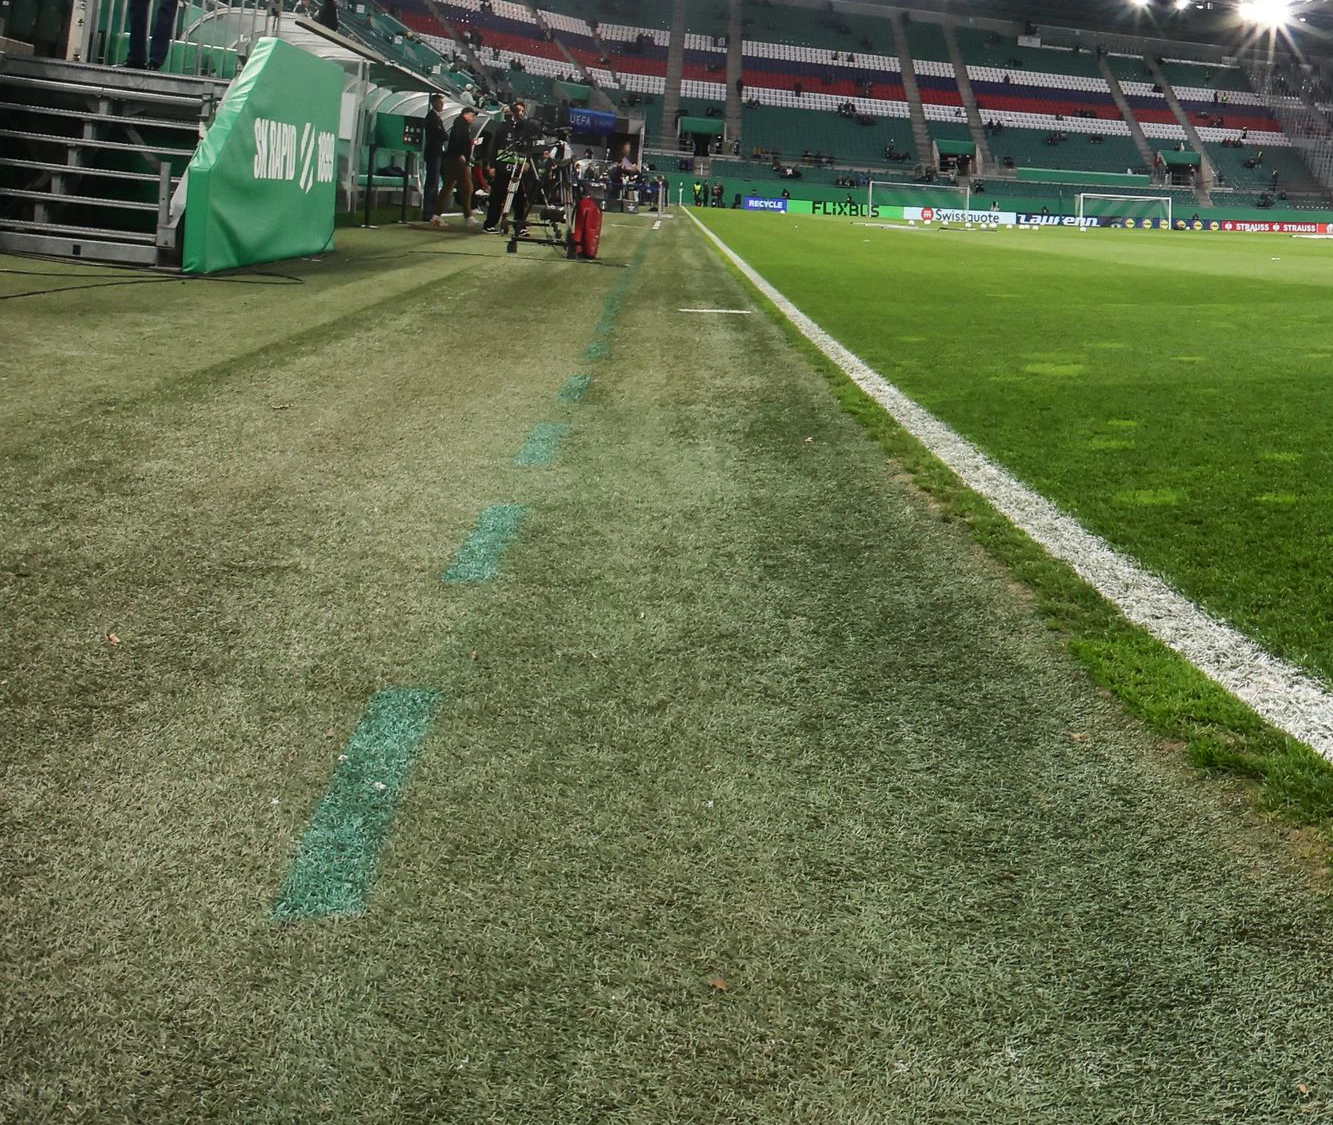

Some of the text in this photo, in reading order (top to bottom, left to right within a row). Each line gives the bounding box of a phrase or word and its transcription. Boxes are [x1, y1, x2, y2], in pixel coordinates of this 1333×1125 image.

[570, 115, 591, 125] UEFA
[748, 199, 783, 209] RECYCLE
[1235, 223, 1269, 231] STRAUSS
